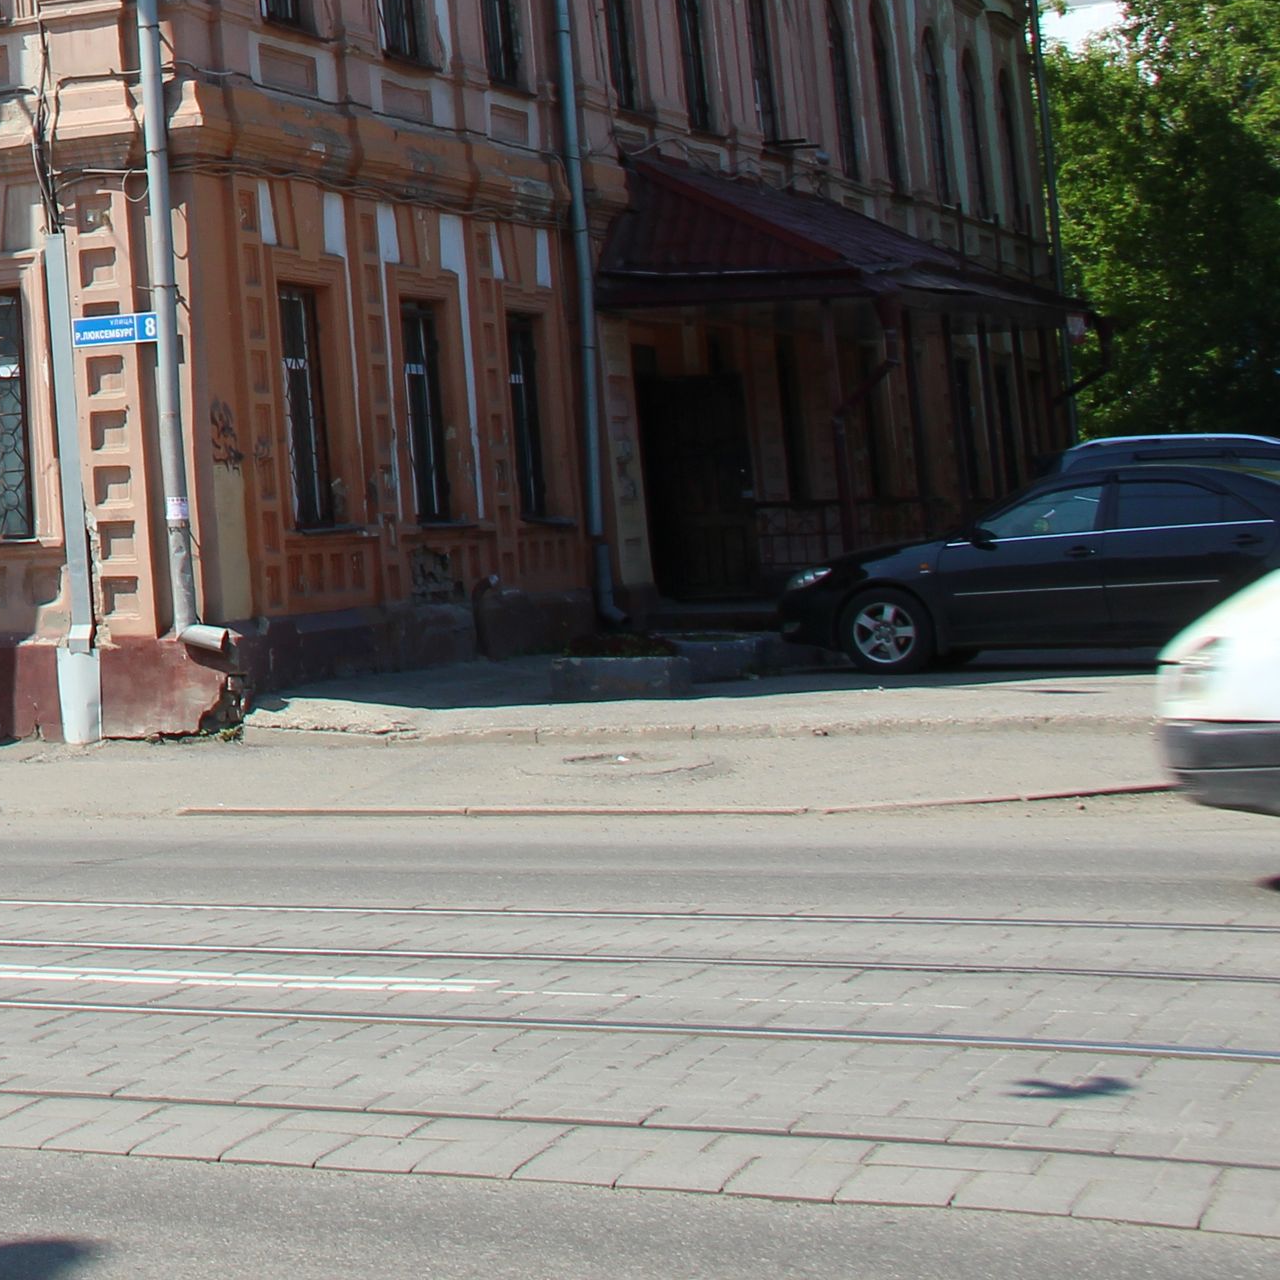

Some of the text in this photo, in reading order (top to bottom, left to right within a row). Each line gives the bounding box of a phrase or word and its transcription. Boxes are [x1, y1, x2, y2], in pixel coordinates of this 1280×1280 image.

[109, 318, 133, 326] УЛИЦА
[144, 317, 156, 337] 8
[75, 328, 133, 341] Р.ЛЮКСЕМБУРГ
